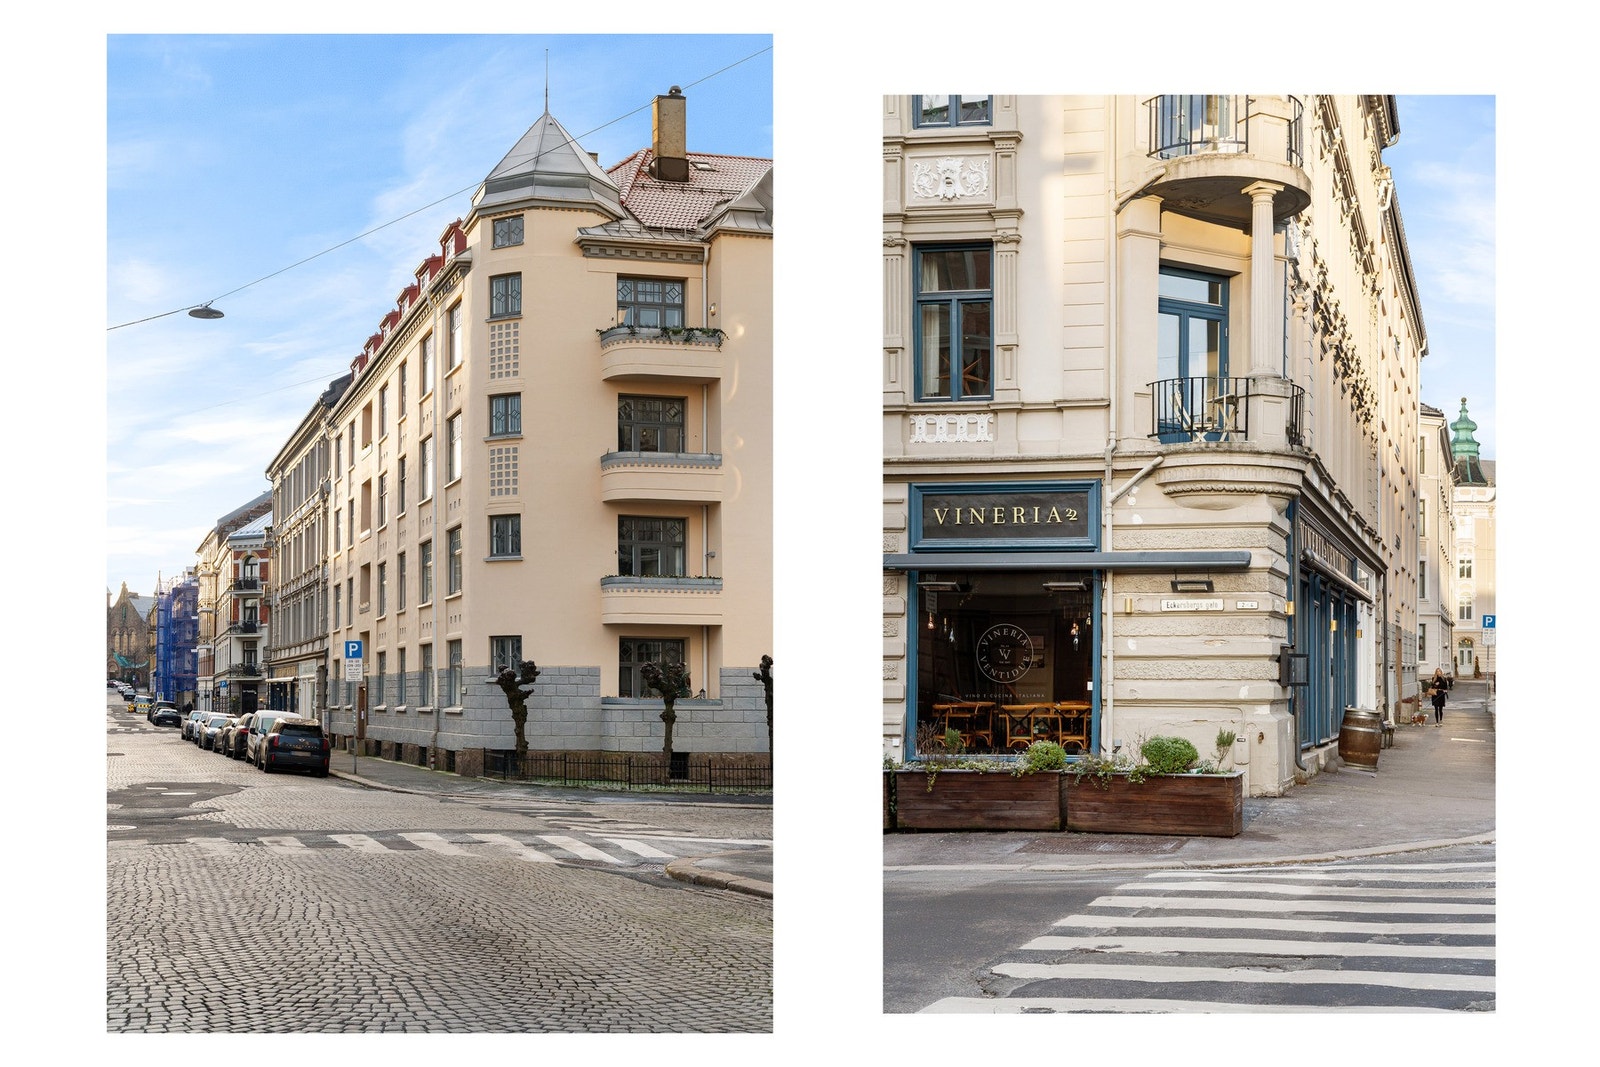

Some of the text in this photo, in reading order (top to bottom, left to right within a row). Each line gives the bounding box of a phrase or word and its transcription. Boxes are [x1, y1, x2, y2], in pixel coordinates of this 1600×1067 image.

[1485, 616, 1493, 627] P
[981, 628, 1028, 646] VINERIA
[348, 643, 359, 657] P
[980, 656, 1030, 679] VENTIDUE
